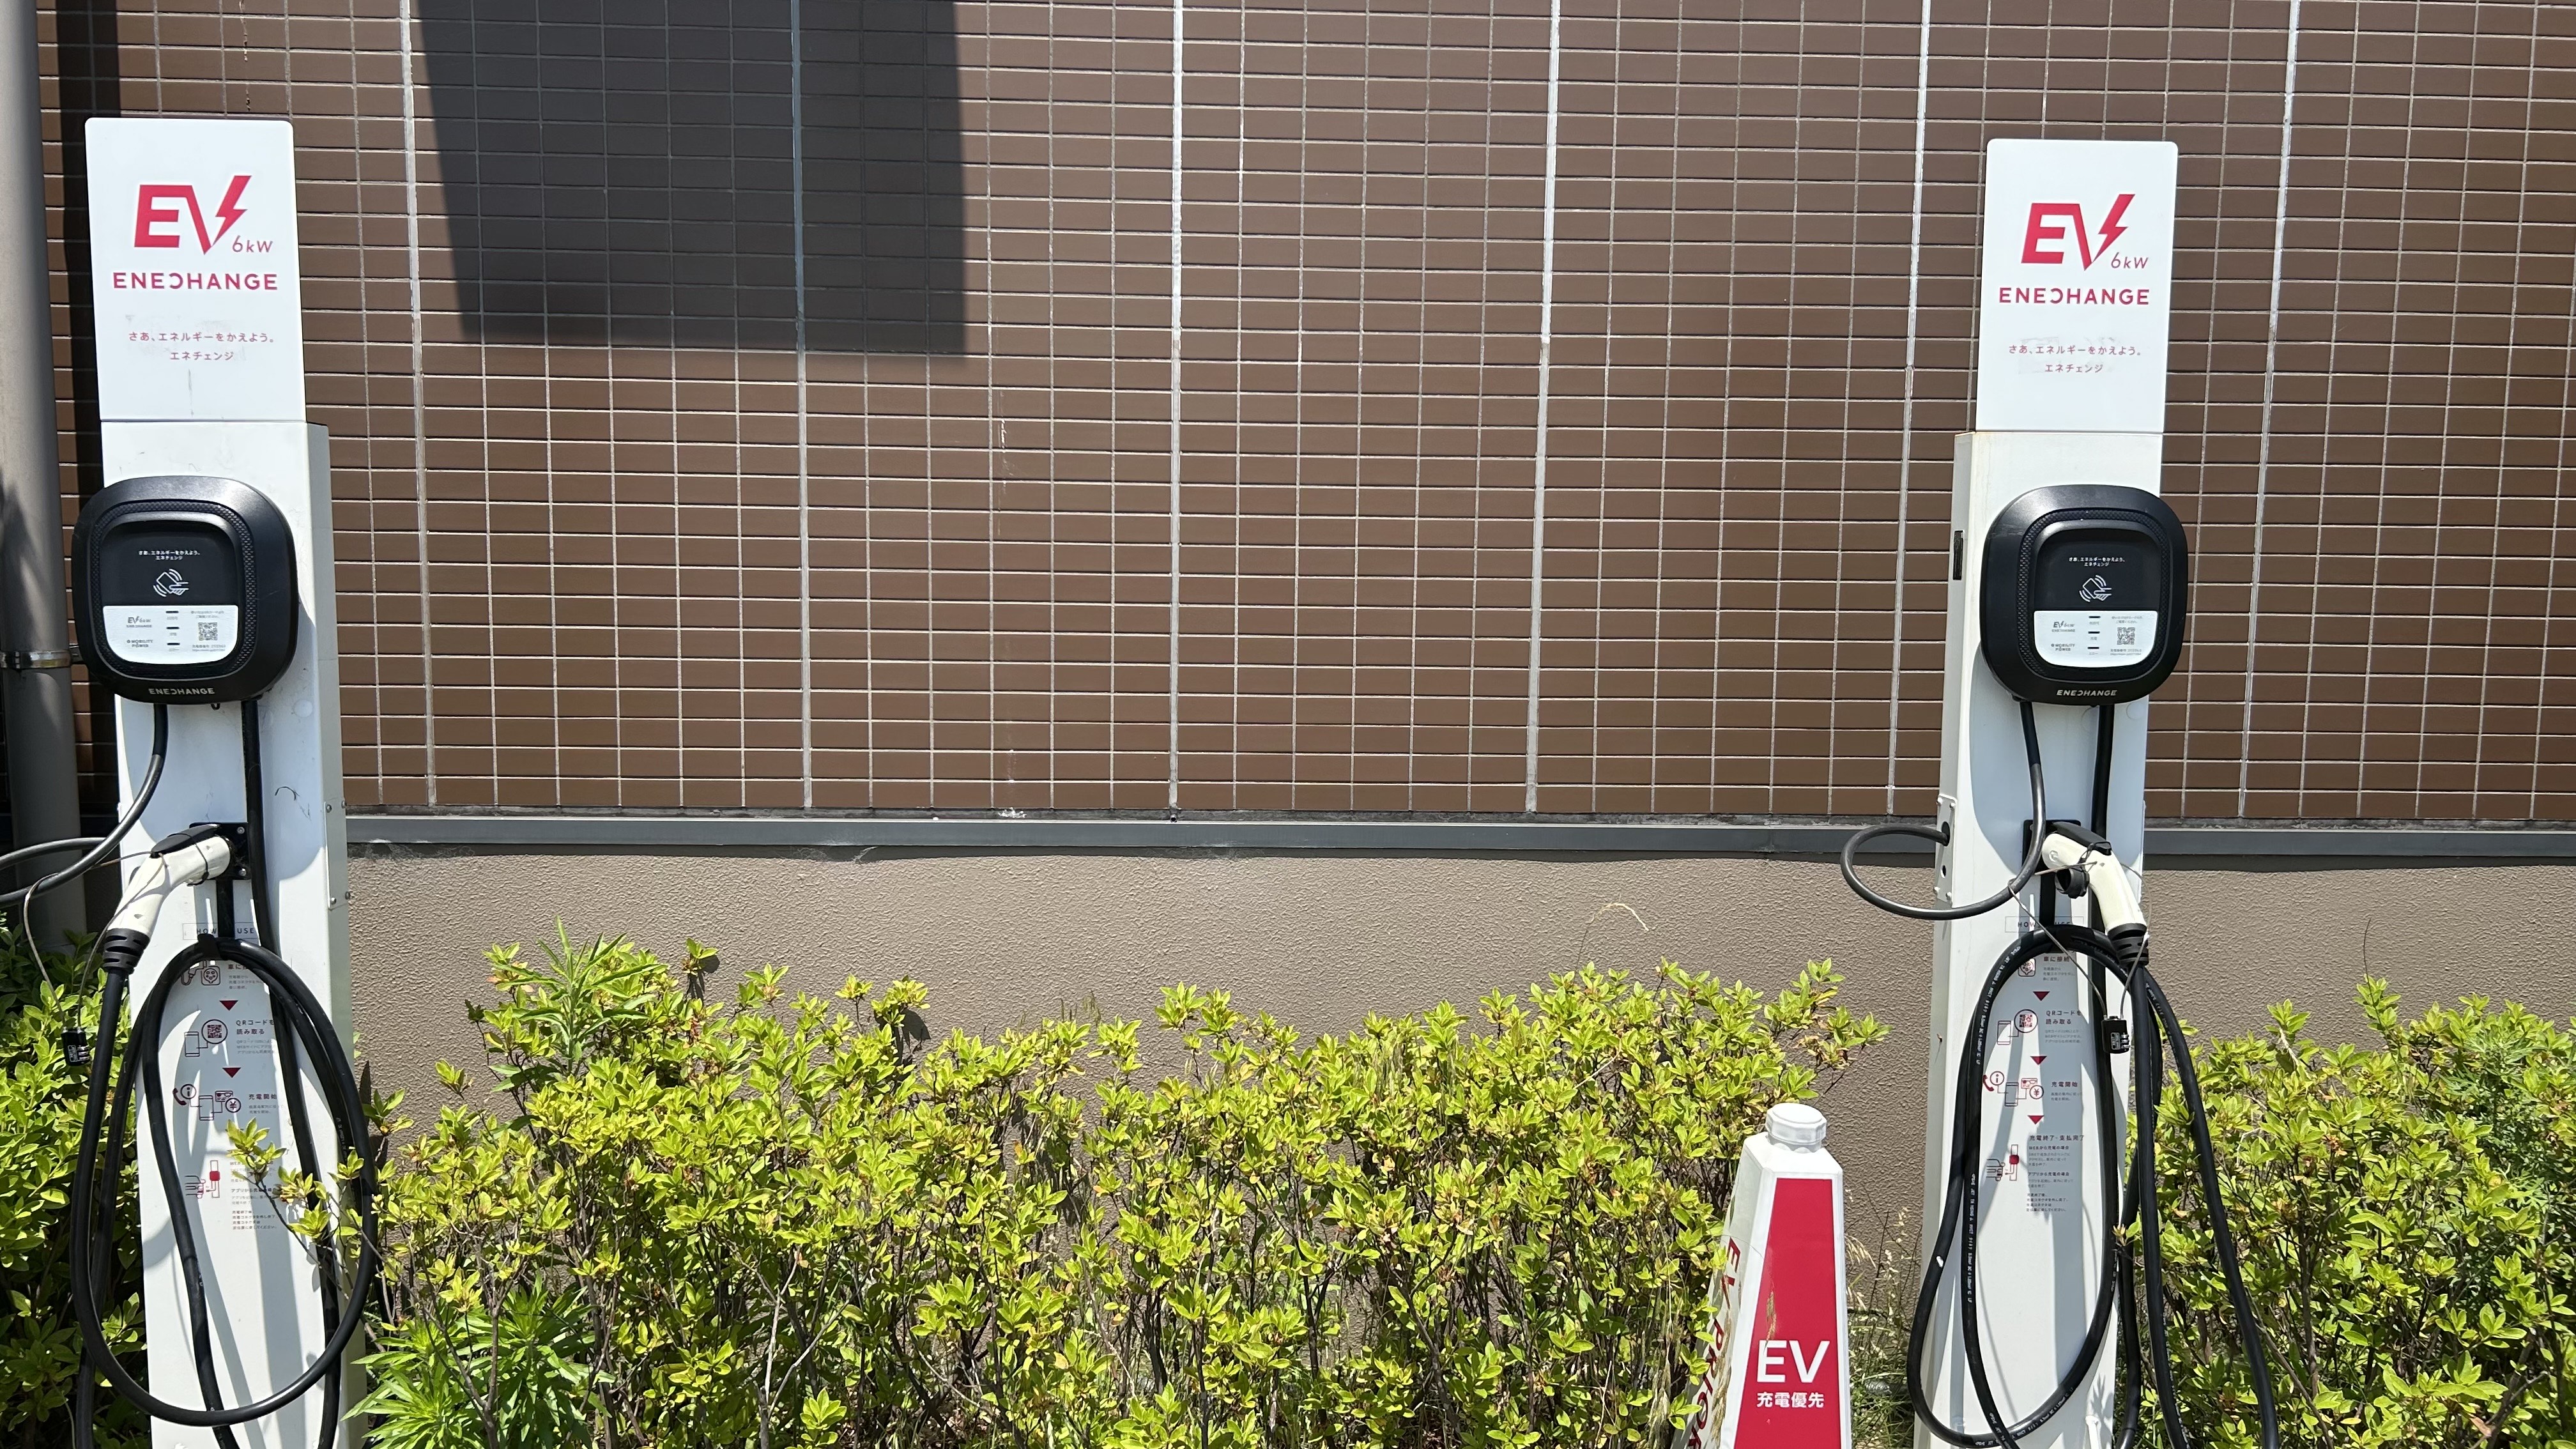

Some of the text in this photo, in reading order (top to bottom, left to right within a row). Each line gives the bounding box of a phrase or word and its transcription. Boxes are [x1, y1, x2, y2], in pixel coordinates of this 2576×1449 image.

[134, 175, 273, 255] EV 6kW
[2021, 194, 2149, 272] EV 6kW
[112, 272, 278, 290] ENECHANGE
[1999, 288, 2149, 305] ENECHANGE
[128, 331, 275, 342] さあ、エネルギーをかえよう。
[170, 351, 234, 361] エネチェンジ
[2009, 345, 2142, 356] さあ、エネルギーをかえよう。
[2044, 364, 2103, 373] エネチェンジ
[1756, 1340, 1830, 1383] EV
[1756, 1391, 1825, 1408] 充電優先
